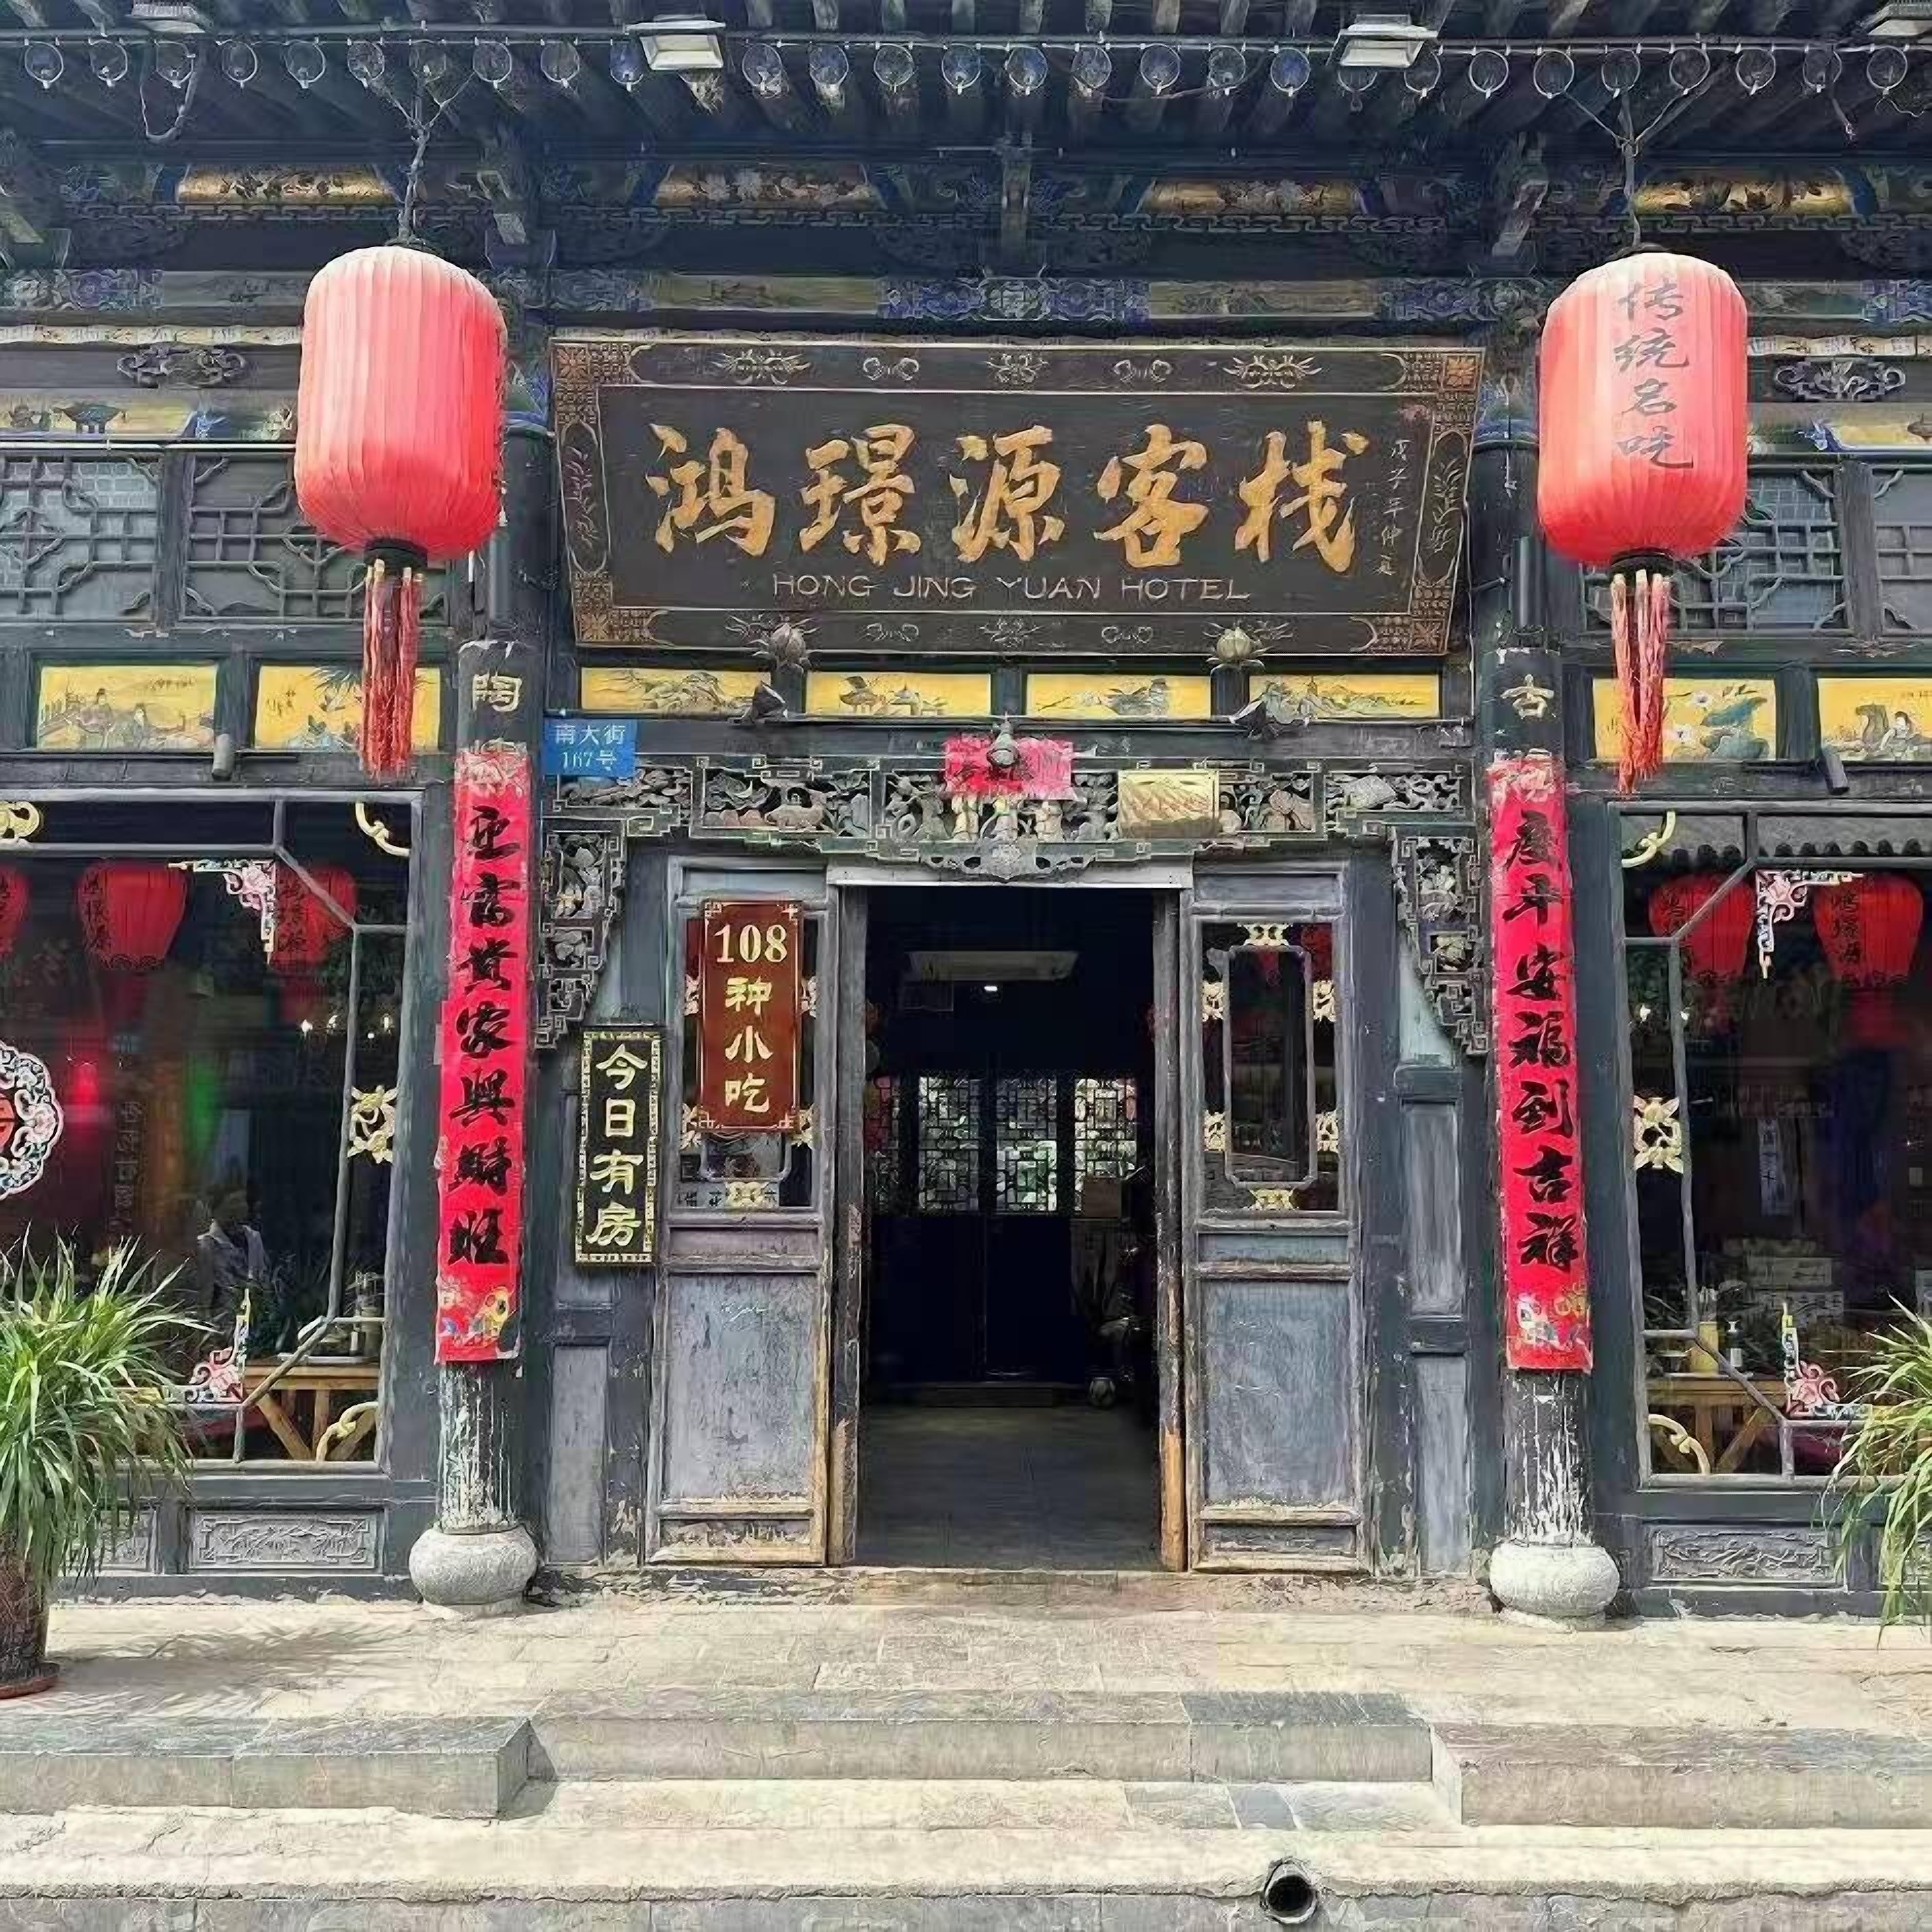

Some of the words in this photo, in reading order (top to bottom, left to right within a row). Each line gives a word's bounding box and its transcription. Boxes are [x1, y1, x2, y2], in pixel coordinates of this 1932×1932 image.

[1614, 278, 1694, 468] 传统名吃
[645, 420, 1369, 572] 鸿璟源客栈
[773, 574, 876, 598] HONG
[893, 575, 977, 599] JING
[996, 576, 1101, 600] YUAN
[1122, 578, 1250, 601] HOTEL
[554, 723, 625, 746] 南大街
[714, 924, 788, 963] 108
[586, 1043, 648, 1248] 今日有房
